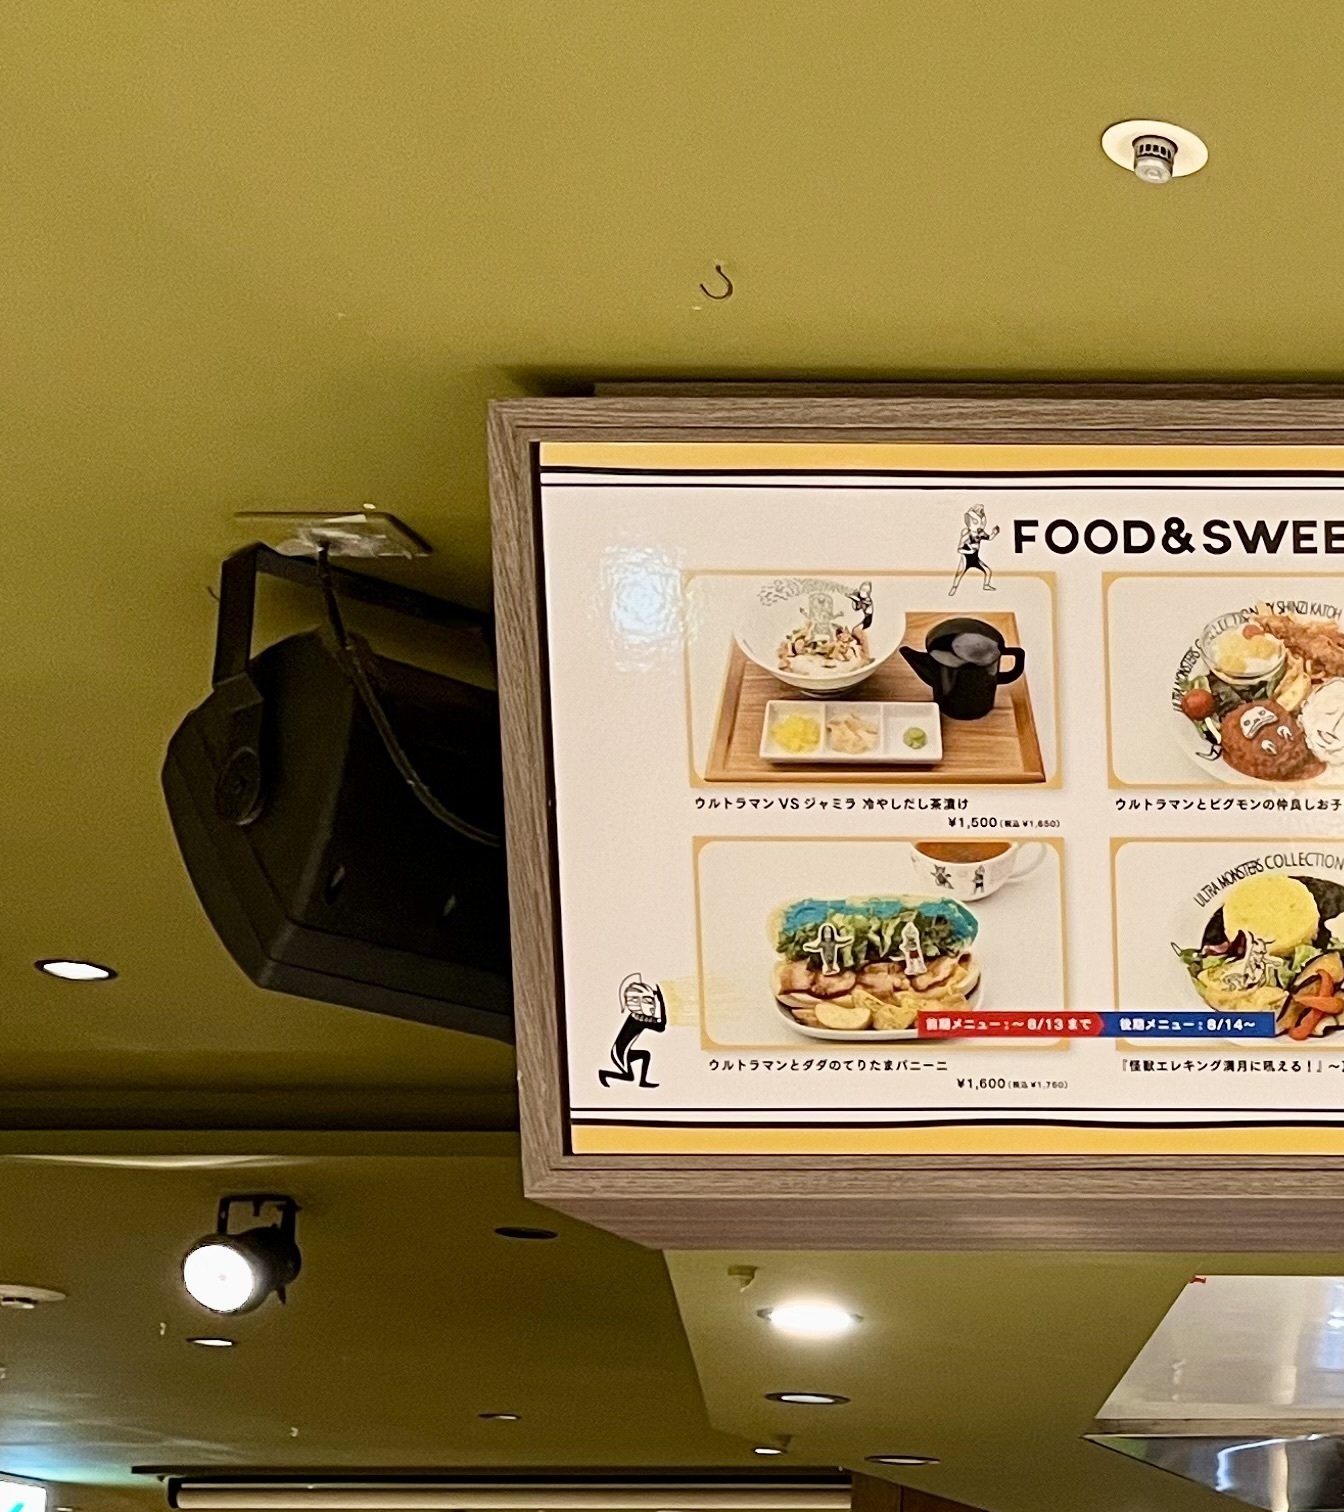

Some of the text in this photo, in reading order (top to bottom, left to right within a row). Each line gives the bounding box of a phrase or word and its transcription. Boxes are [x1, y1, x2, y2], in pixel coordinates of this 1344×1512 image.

[695, 797, 775, 811] ウルトラマン
[778, 798, 800, 810] VS
[804, 797, 857, 811] ジャミラ
[948, 816, 998, 829] ¥1,500
[1264, 852, 1344, 871] COLLECTION
[956, 1078, 1006, 1091] ¥1,600
